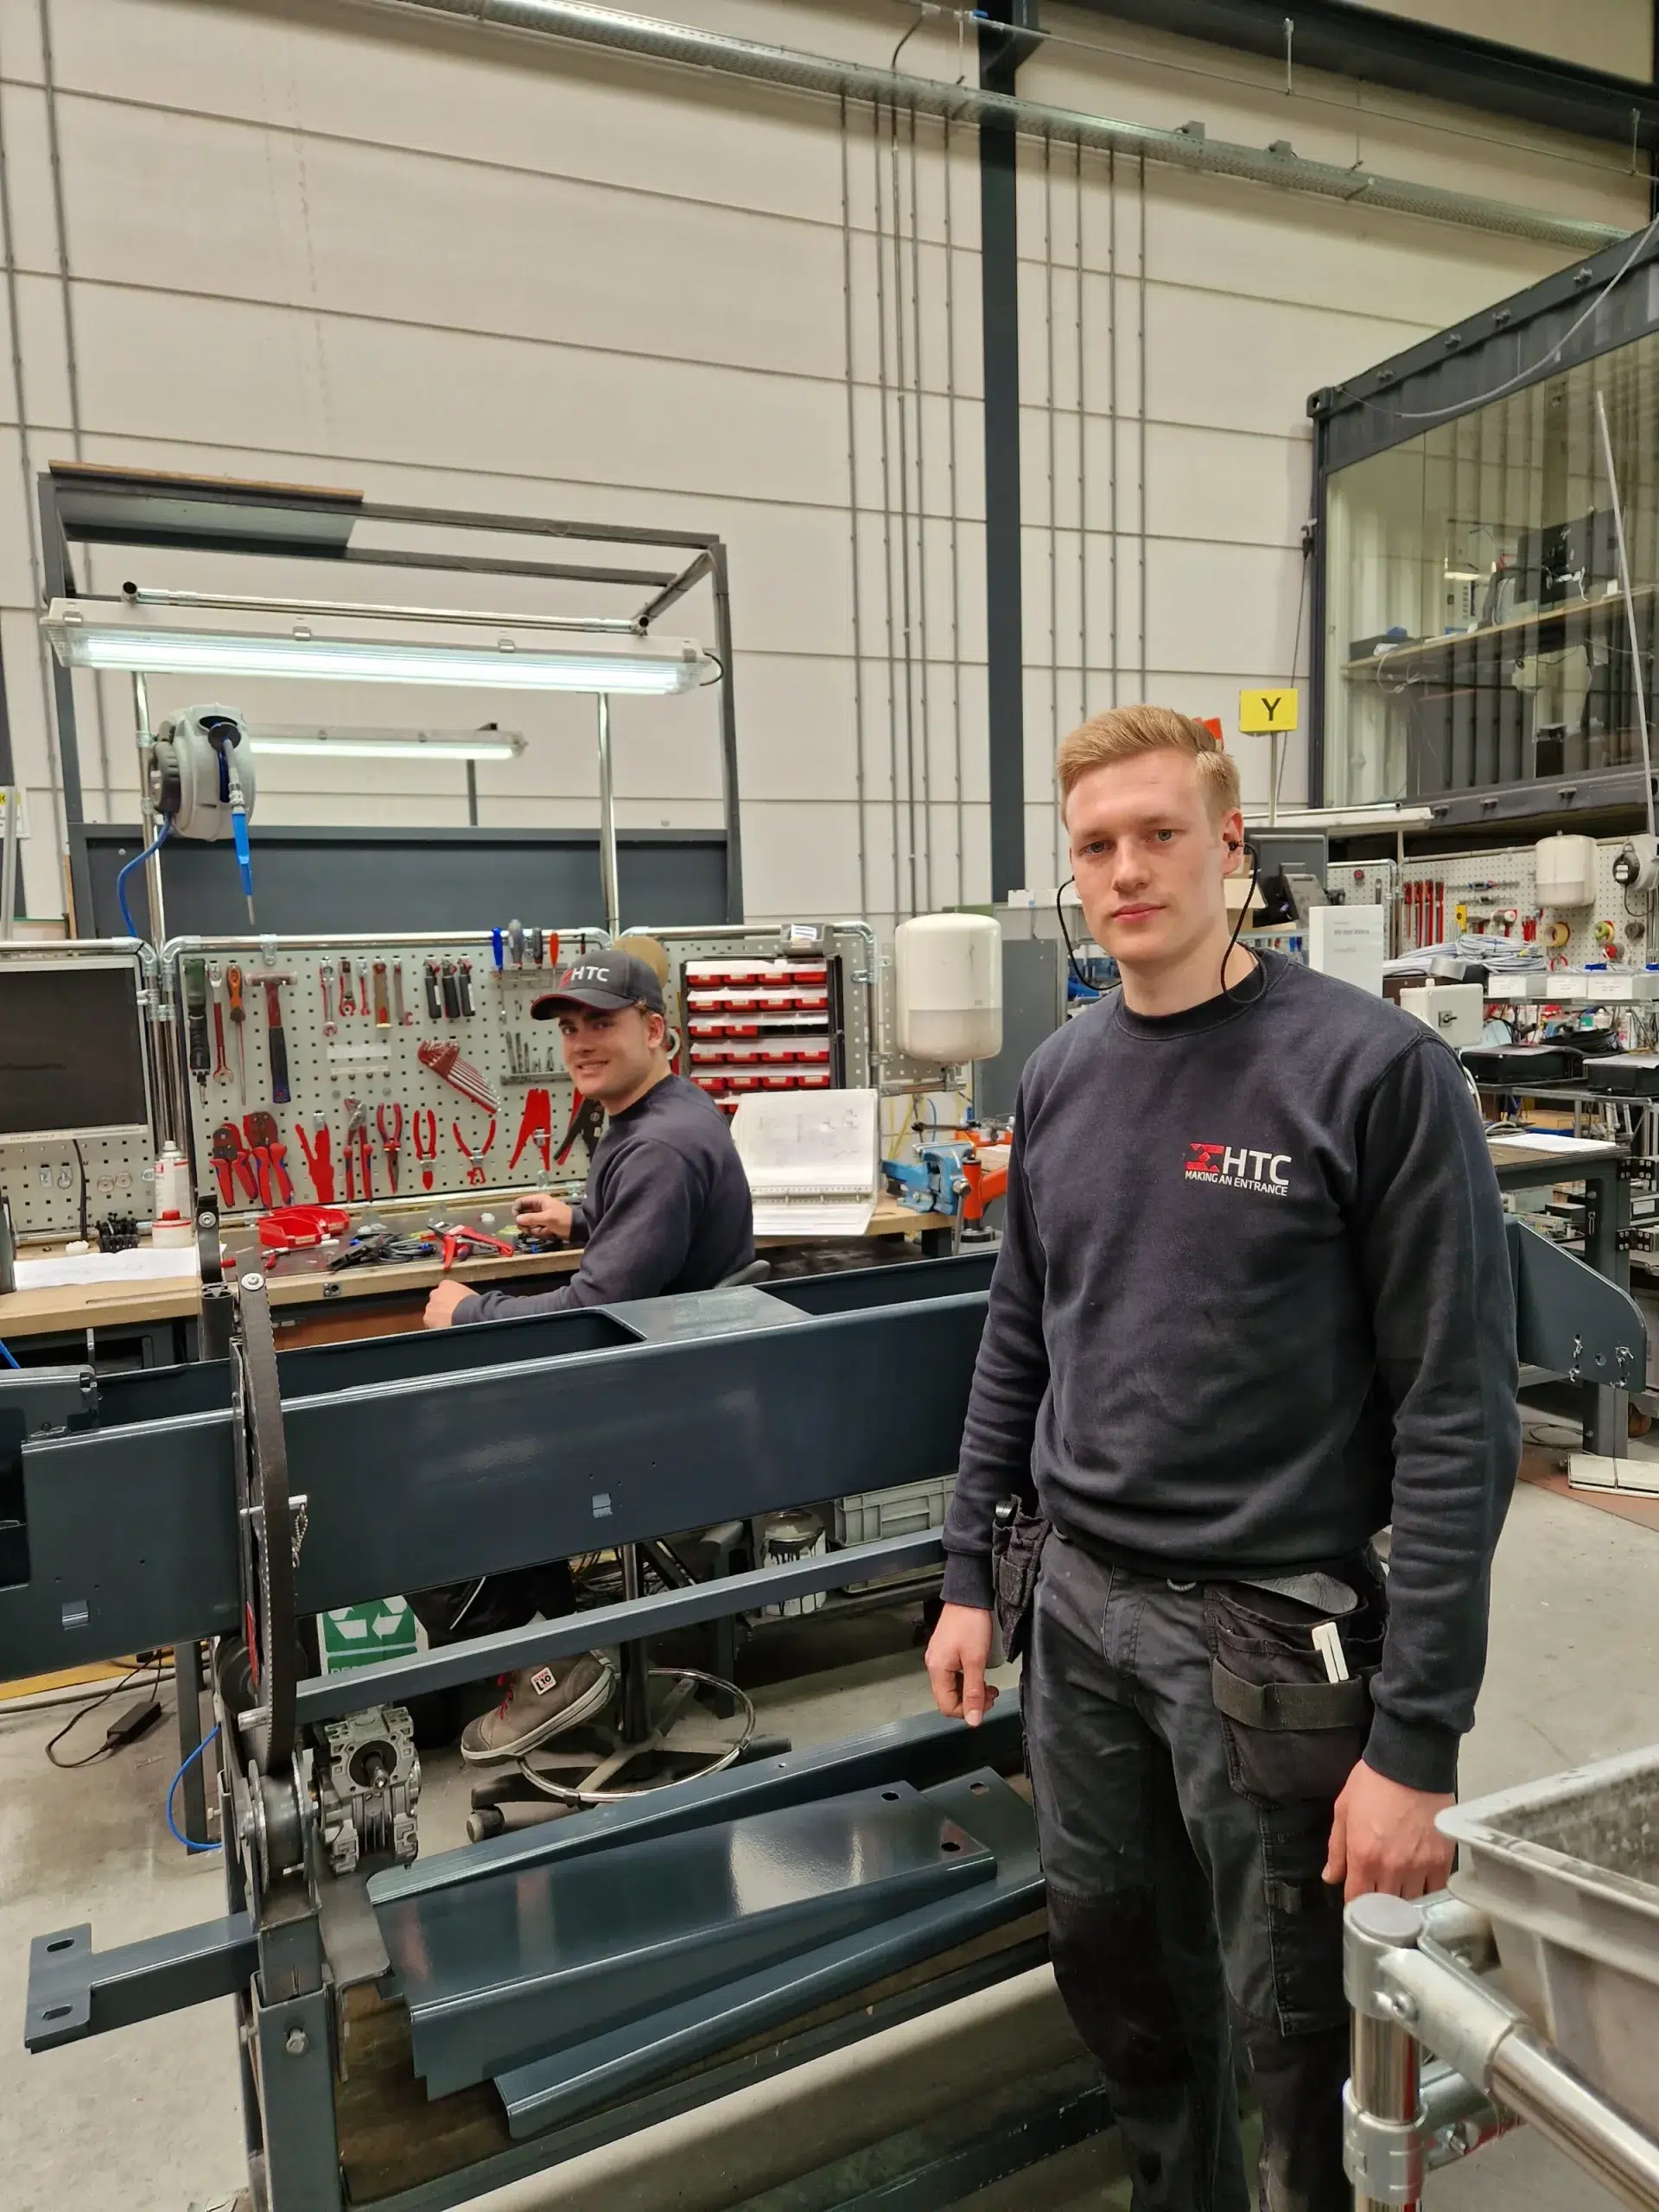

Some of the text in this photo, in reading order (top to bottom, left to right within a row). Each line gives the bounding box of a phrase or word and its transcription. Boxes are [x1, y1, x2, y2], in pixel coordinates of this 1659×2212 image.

[1261, 696, 1281, 721] Y
[570, 966, 610, 982] HTC
[1223, 1146, 1292, 1185] HTC
[1185, 1170, 1288, 1197] MAKING AN ENTRANCE
